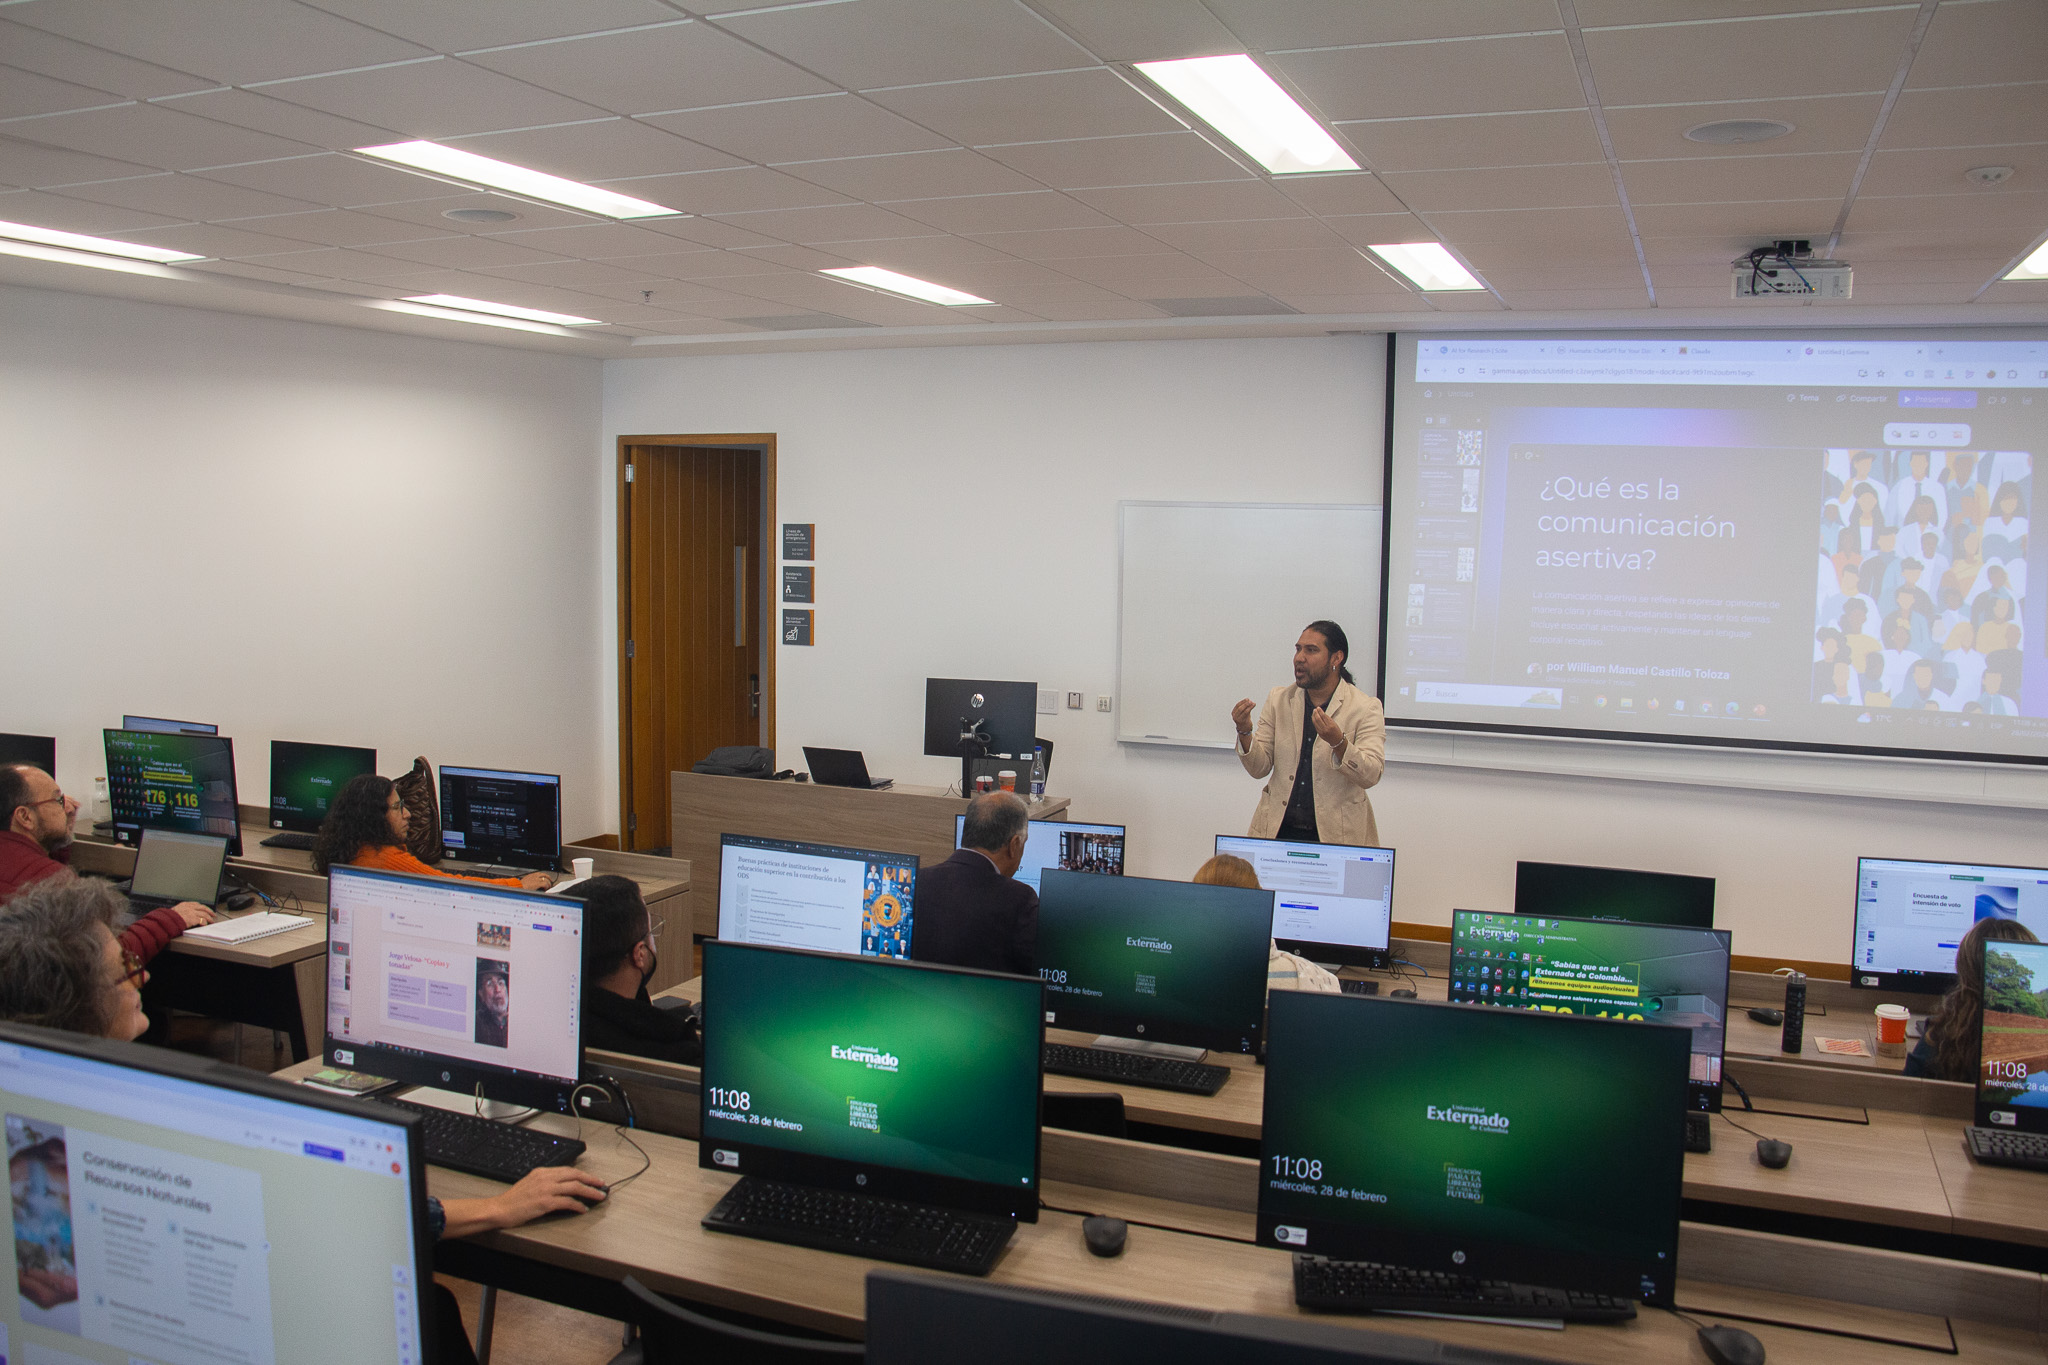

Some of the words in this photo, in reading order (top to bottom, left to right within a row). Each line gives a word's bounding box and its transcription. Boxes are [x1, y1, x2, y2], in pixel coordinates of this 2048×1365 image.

[1800, 394, 1819, 402] Tema
[1540, 476, 1611, 501] ¿Qué
[1620, 482, 1649, 499] es
[1658, 478, 1680, 500] la
[1537, 512, 1736, 538] comunicación
[1536, 547, 1657, 571] asertiva?
[1544, 592, 1602, 601] comunicación
[1604, 593, 1637, 602] asertiva
[1651, 595, 1678, 604] refiere
[1687, 597, 1723, 607] expresar
[1725, 599, 1768, 609] opiniones
[1769, 600, 1780, 609] de
[1532, 606, 1563, 614] manera
[1564, 606, 1585, 616] clara
[1624, 609, 1673, 620] respetando
[1674, 611, 1687, 620] las
[1688, 612, 1712, 621] ideas
[1561, 622, 1599, 631] escuchar
[1601, 624, 1652, 634] activamente
[1660, 626, 1700, 636] mantener
[1715, 628, 1752, 640] lenguaje
[1529, 636, 1564, 645] corporal
[1546, 662, 1564, 673] por
[1566, 662, 1606, 674] William
[1608, 664, 1648, 676] Manuel
[1650, 666, 1692, 678] Castillo
[1694, 668, 1730, 680] Toloza
[1436, 690, 1458, 698] Buscar
[144, 790, 166, 804] 176
[176, 792, 198, 808] 116
[738, 856, 756, 866] Buenas
[757, 859, 780, 869] prácticas
[738, 864, 764, 874] educación
[764, 868, 786, 878] superior
[800, 872, 834, 882] contribución
[1912, 892, 1940, 900] Encuesta
[1470, 926, 1520, 939] Externado
[1126, 936, 1172, 950] Externado
[389, 952, 404, 960] Jorge
[1038, 968, 1067, 984] 11:08
[1535, 968, 1574, 978] Externado
[1576, 970, 1586, 978] de
[1588, 972, 1632, 983] Colombia...
[1047, 985, 1064, 993] rcoles,
[1074, 986, 1080, 994] de
[1082, 988, 1102, 998] febrero
[1532, 979, 1566, 987] renovamos
[1567, 982, 1592, 990] equipos
[1592, 984, 1635, 993] audiovisuales
[831, 1045, 899, 1067] Externado
[851, 1044, 878, 1054] Universidad
[874, 1064, 898, 1072] Colombia
[1986, 1060, 2026, 1078] 11:08
[1985, 1079, 2024, 1090] miércoles,
[2026, 1082, 2036, 1090] 28
[709, 1086, 750, 1111] 11:08
[850, 1104, 868, 1112] PARA
[1452, 1104, 1485, 1113] Universidad
[709, 1108, 748, 1124] miércoles,
[748, 1114, 760, 1124] 28
[760, 1116, 772, 1126] de
[773, 1117, 803, 1132] febrero
[850, 1111, 878, 1120] LIBERTAD
[1427, 1105, 1510, 1128] Externado
[850, 1120, 878, 1130] FUTURO
[1479, 1126, 1508, 1134] Colombia
[82, 1150, 173, 1183] Conservación
[174, 1173, 192, 1189] de
[1272, 1154, 1322, 1180] 11:08
[1448, 1166, 1482, 1176] EDUCACIÓN
[1448, 1172, 1469, 1181] PARA
[1447, 1180, 1482, 1188] LIBERTAD
[84, 1171, 144, 1198] Recursos
[146, 1184, 212, 1214] Naturales
[1270, 1179, 1318, 1195] miércoles,
[1320, 1184, 1334, 1196] 28
[1336, 1186, 1349, 1198] de
[1351, 1189, 1388, 1204] febrero
[1446, 1190, 1481, 1200] FUTURO
